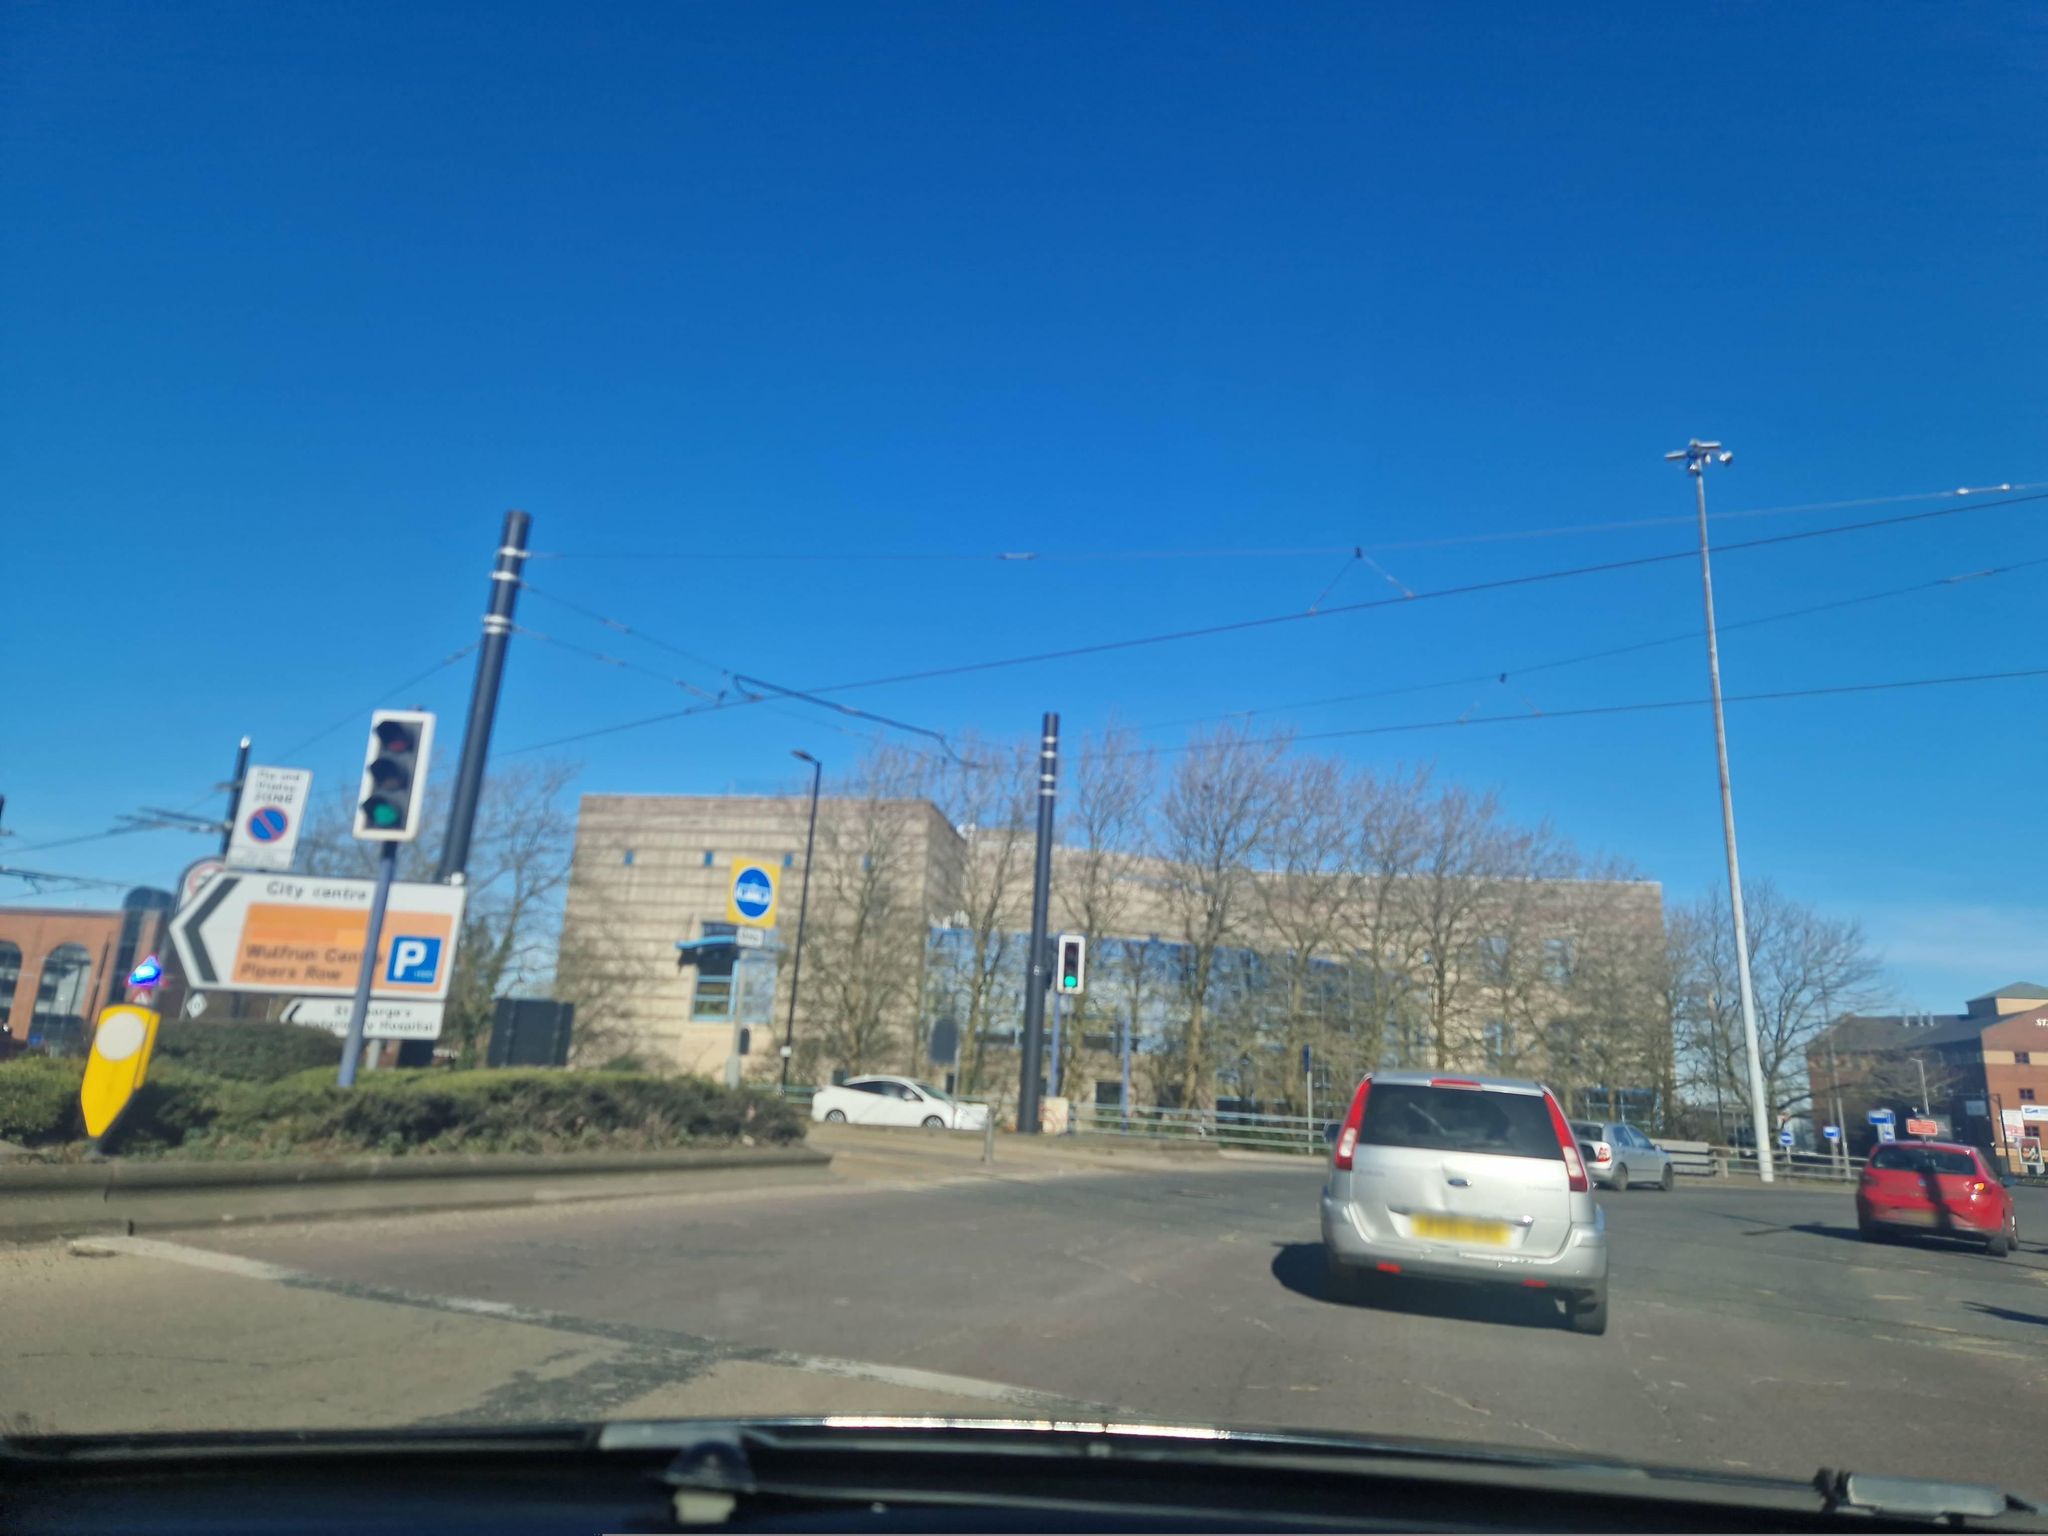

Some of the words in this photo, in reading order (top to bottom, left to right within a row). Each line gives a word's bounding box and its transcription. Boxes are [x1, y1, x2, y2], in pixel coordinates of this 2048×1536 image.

[266, 880, 303, 901] City
[312, 887, 366, 901] centre
[393, 940, 429, 980] P
[303, 964, 342, 982] Row
